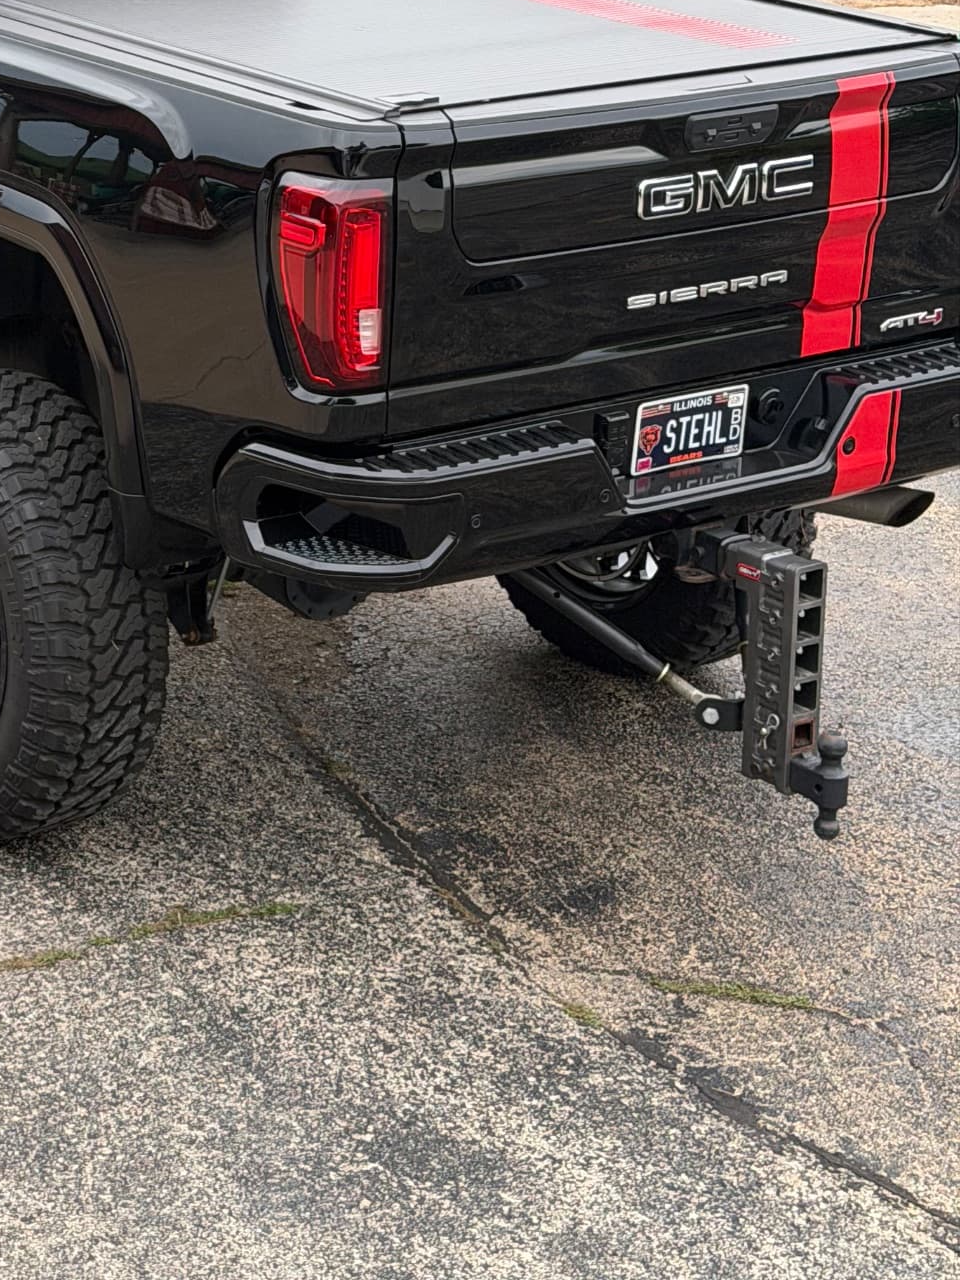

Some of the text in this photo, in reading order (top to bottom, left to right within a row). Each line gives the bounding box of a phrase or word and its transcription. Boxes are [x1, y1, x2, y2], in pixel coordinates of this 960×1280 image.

[638, 154, 814, 220] GMC
[627, 270, 788, 309] SIERRA
[880, 307, 944, 332] AT4
[673, 396, 712, 411] ILLINOIS
[663, 410, 726, 453] STEHL
